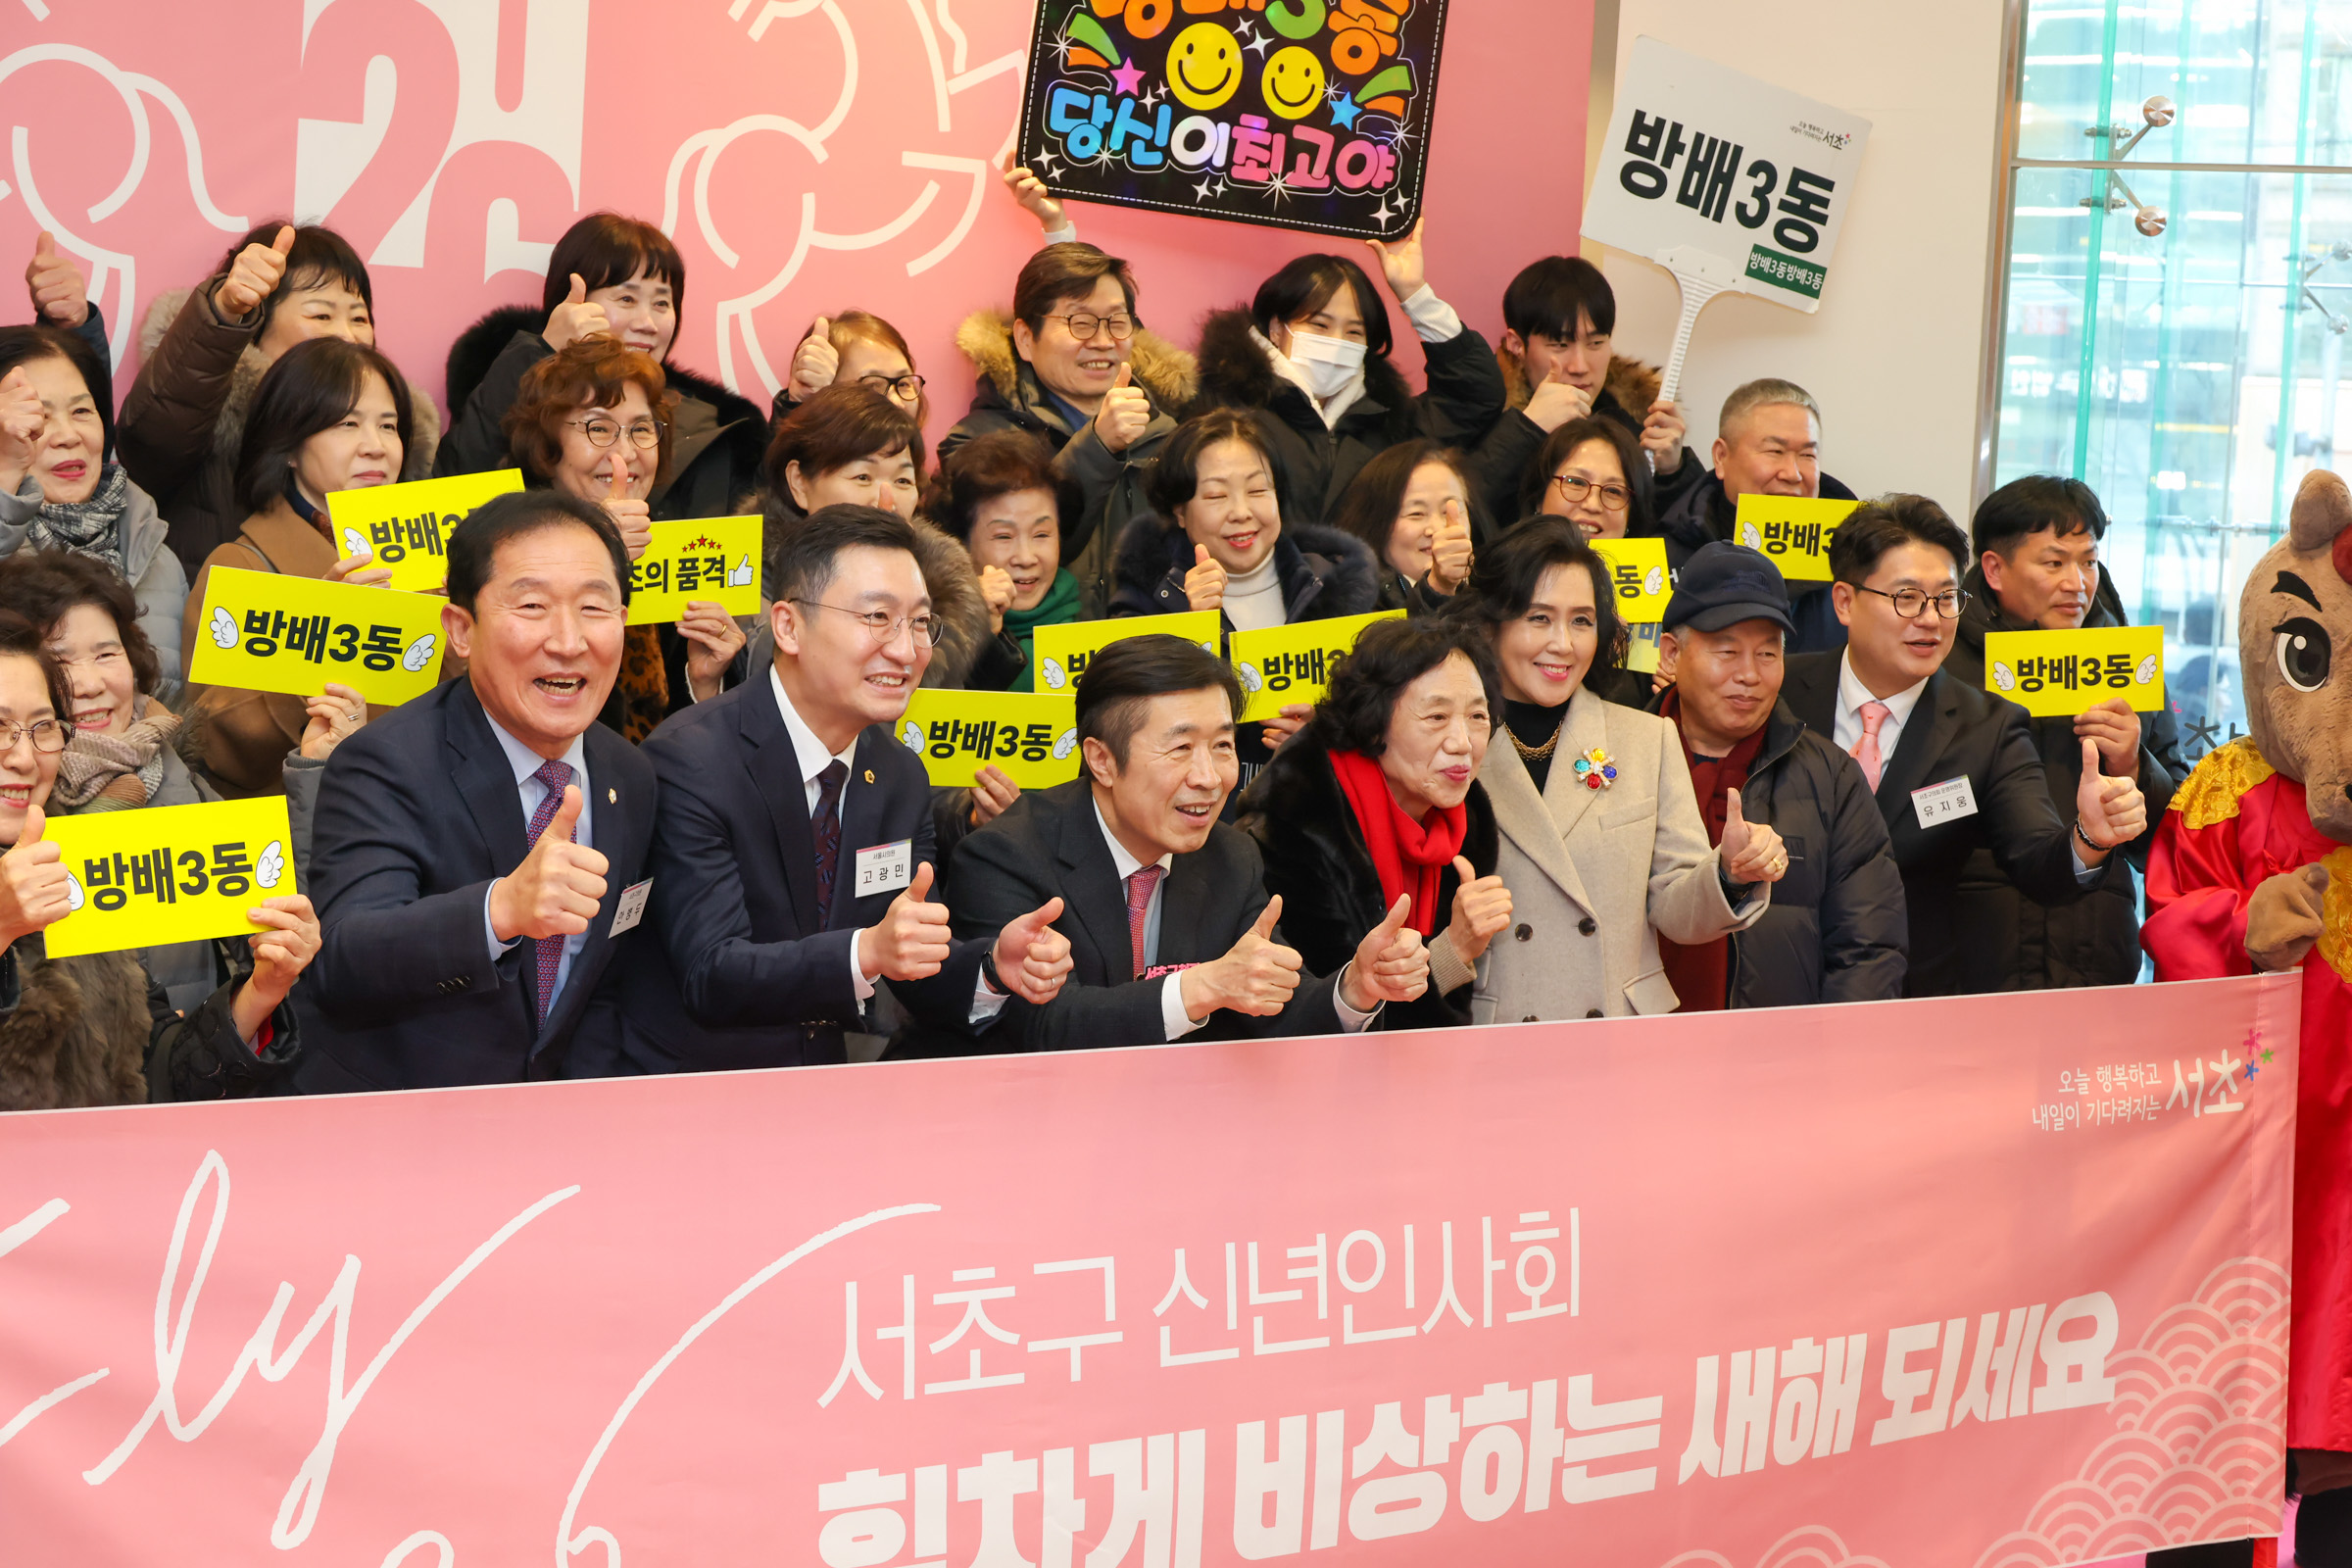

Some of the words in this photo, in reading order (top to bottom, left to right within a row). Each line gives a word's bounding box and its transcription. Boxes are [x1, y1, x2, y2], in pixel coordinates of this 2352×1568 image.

[1822, 130, 1844, 150] 서초
[1619, 108, 1836, 254] 방배3동
[675, 554, 726, 592] 품격
[242, 609, 404, 672] 방배3동
[2017, 654, 2134, 693] 방배3동
[928, 719, 1054, 761] 방배3동
[83, 840, 255, 910] 방배3동
[2058, 1068, 2090, 1096] 오늘
[2095, 1061, 2162, 1094] 행복하고
[2165, 1049, 2244, 1118] 서초
[2032, 1101, 2080, 1131] 내일이
[2086, 1094, 2162, 1126] 기다려지는
[816, 1254, 1124, 1409] 서초구
[1152, 1206, 1581, 1369] 신년인사회
[1233, 1373, 1664, 1561] 비상하는
[1677, 1332, 1868, 1486] 새해
[1870, 1290, 2120, 1446] 되세요
